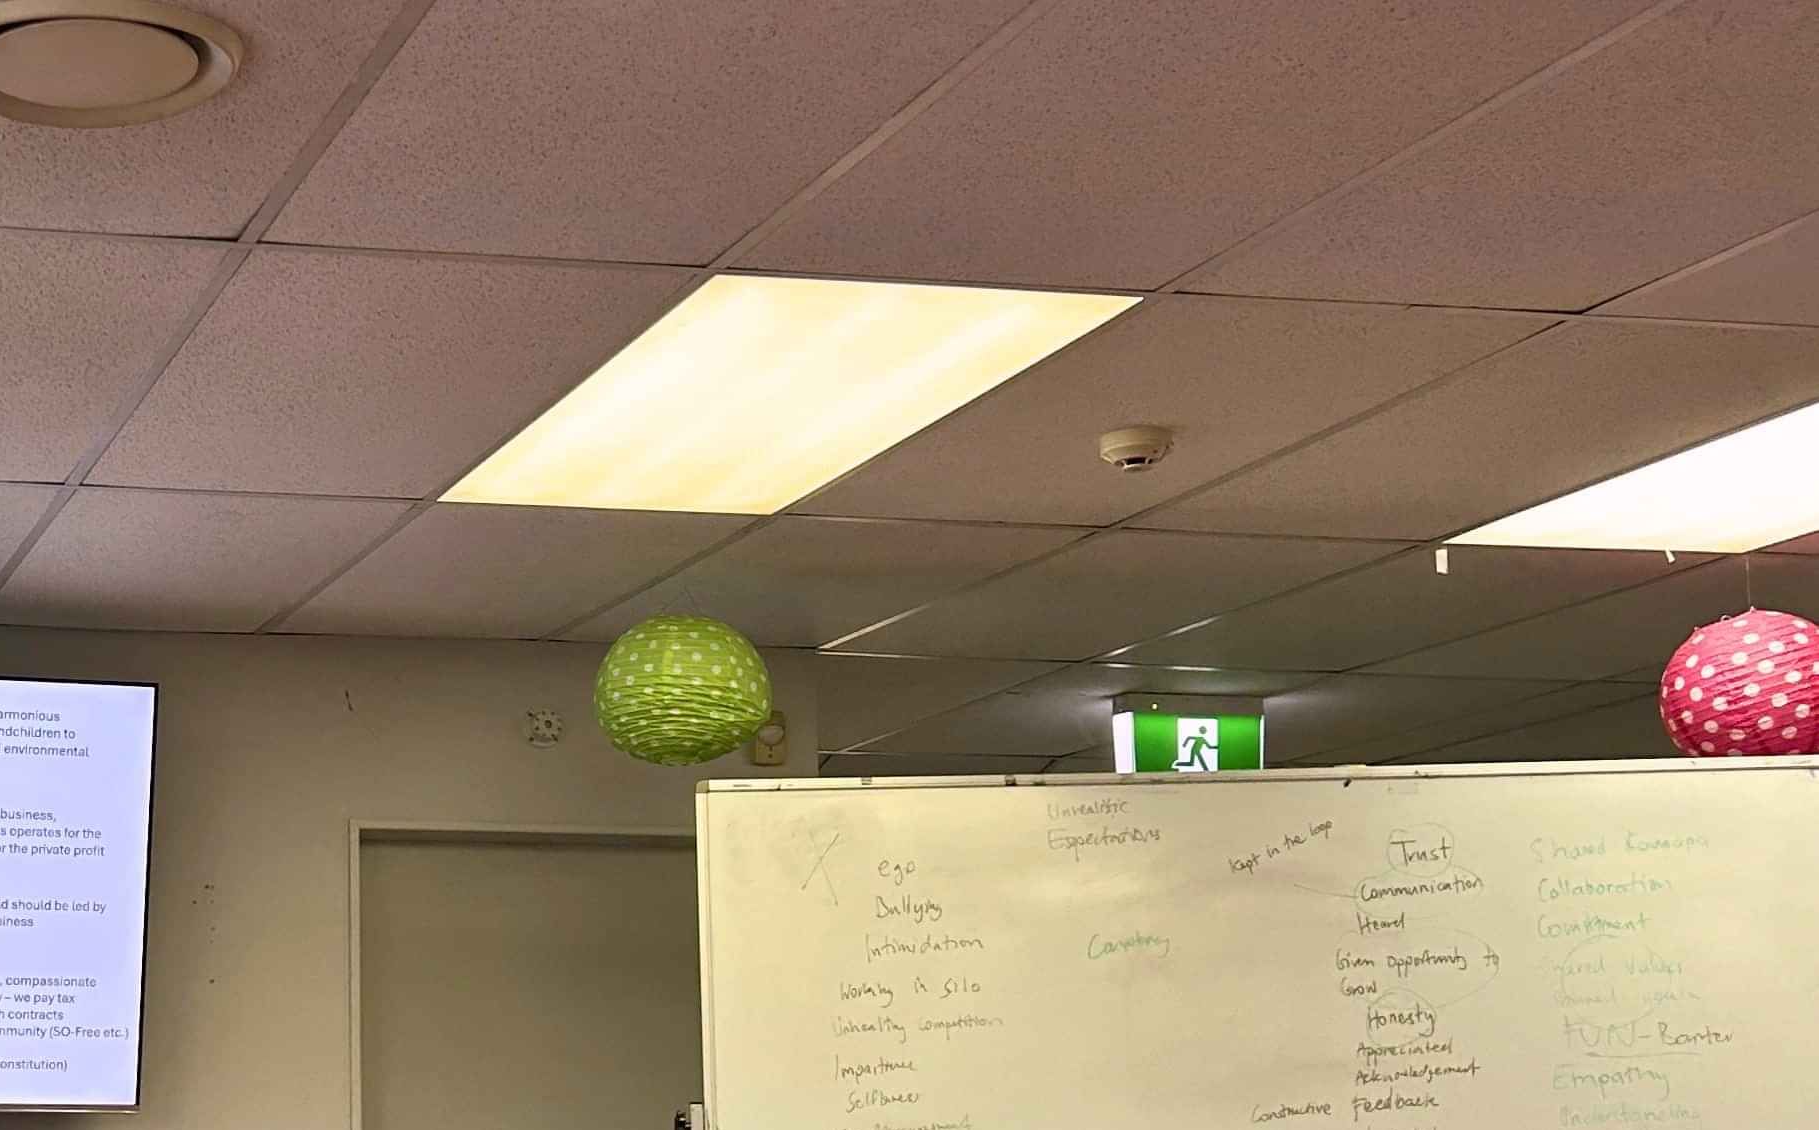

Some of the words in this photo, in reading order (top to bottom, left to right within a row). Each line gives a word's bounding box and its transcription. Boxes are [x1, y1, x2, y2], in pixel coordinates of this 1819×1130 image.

[64, 729, 76, 739] to
[4, 745, 89, 757] environmental
[1047, 799, 1130, 820] Unrealistic
[9, 828, 61, 839] operates
[64, 828, 79, 838] for
[82, 828, 101, 839] the
[9, 844, 28, 854] the
[31, 844, 71, 856] private
[73, 845, 105, 858] profit
[1390, 836, 1451, 867] Trust
[1360, 877, 1484, 902] Communication
[1538, 872, 1673, 903] Collaboration
[12, 900, 52, 911] should
[54, 901, 69, 911] be
[72, 901, 90, 911] led
[93, 901, 106, 914] by
[1356, 911, 1405, 936] Heard
[864, 933, 985, 963] Intimidation
[6, 975, 96, 988] compassionate
[913, 976, 929, 994] in
[14, 993, 31, 1003] we
[33, 994, 55, 1005] pay
[58, 993, 75, 1003] tax
[7, 1010, 64, 1021] contracts
[1367, 1003, 1436, 1038] Honesty
[1550, 1065, 1671, 1103] Empathy
[1351, 1087, 1441, 1122] Feedback
